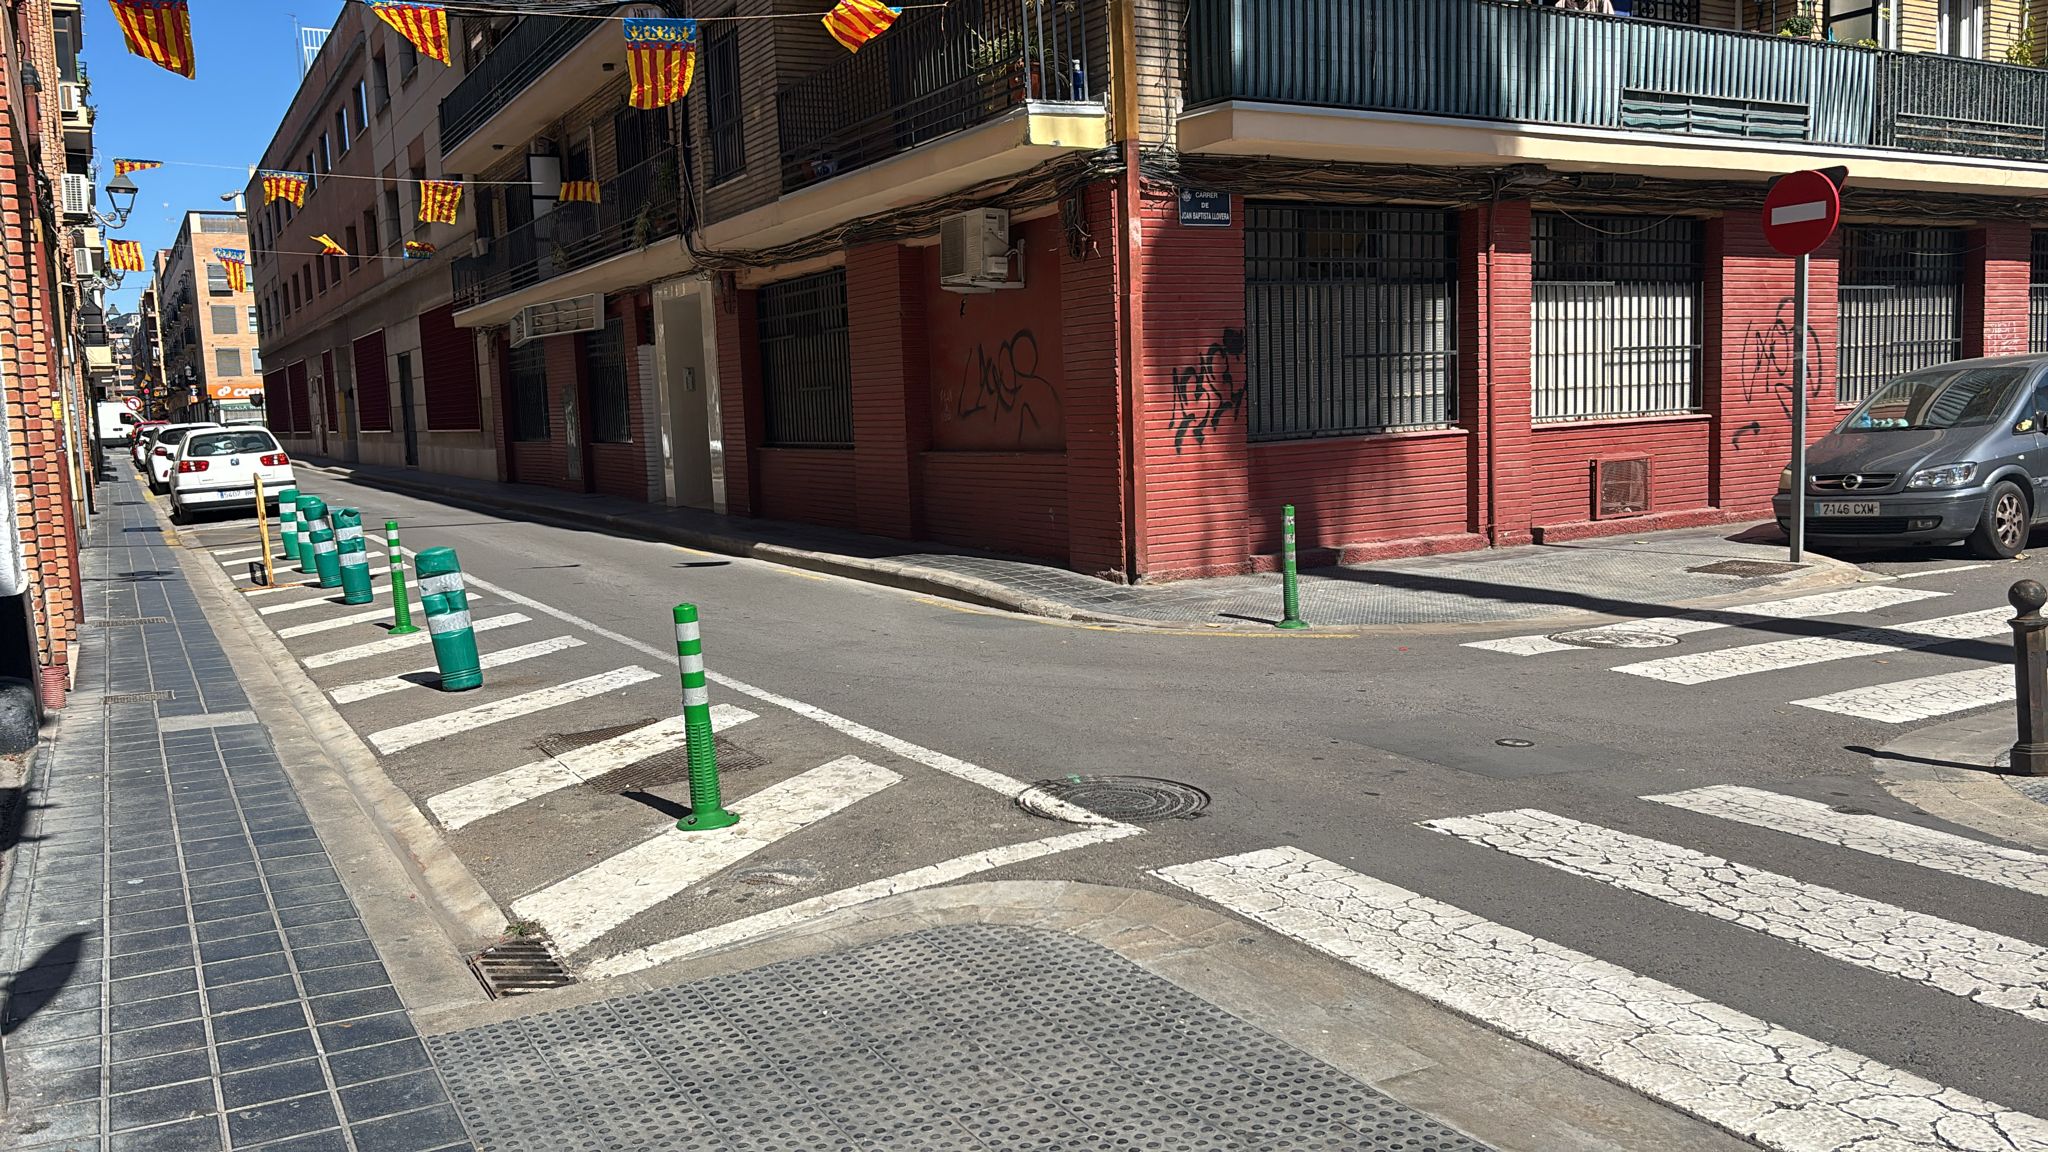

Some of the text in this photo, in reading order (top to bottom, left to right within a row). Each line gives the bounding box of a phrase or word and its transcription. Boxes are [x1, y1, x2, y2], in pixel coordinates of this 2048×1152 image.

[1195, 191, 1218, 199] CARRER
[1181, 212, 1229, 220] JOAN BAPTISTA LLOVERA
[1823, 503, 1874, 515] 7146 CXM
